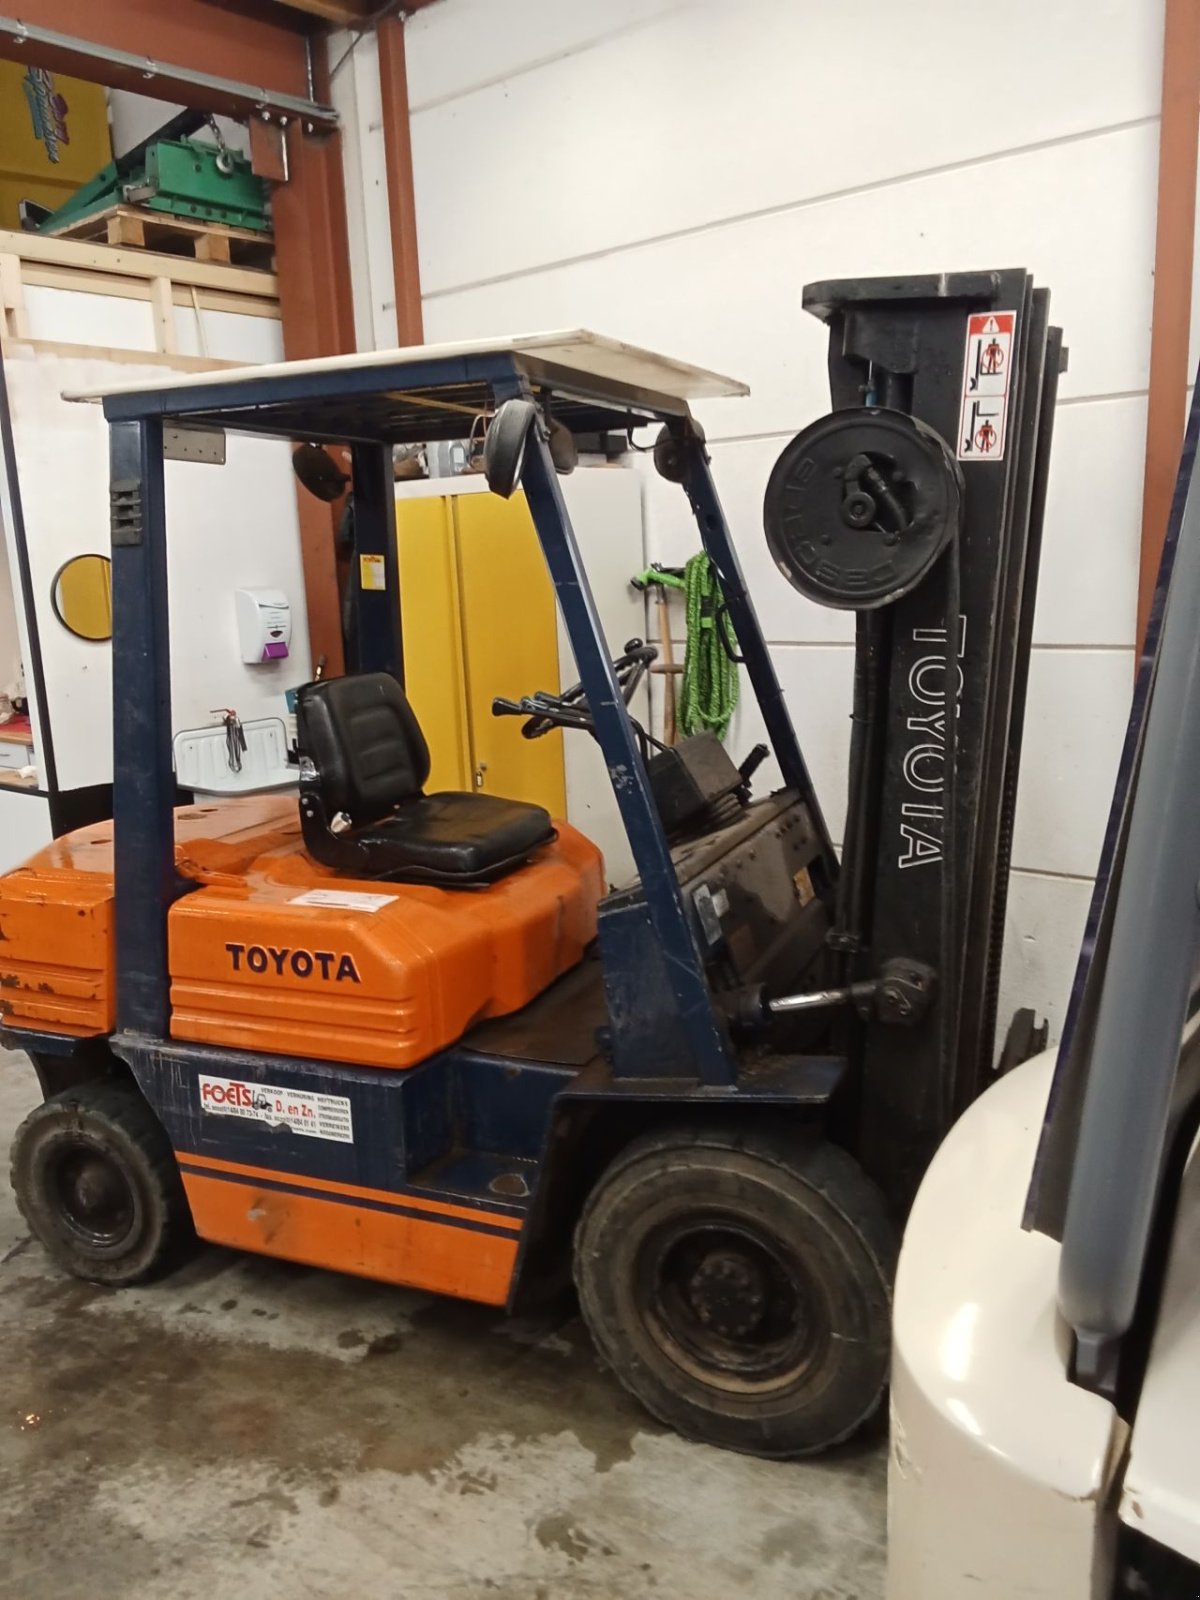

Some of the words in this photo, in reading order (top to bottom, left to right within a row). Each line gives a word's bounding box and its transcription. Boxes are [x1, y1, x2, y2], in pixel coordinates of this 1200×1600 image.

[225, 942, 361, 983] TOYOTA
[202, 1082, 253, 1107] FOETS
[276, 1100, 286, 1114] D.
[288, 1105, 299, 1115] en
[301, 1104, 316, 1118] Zn.
